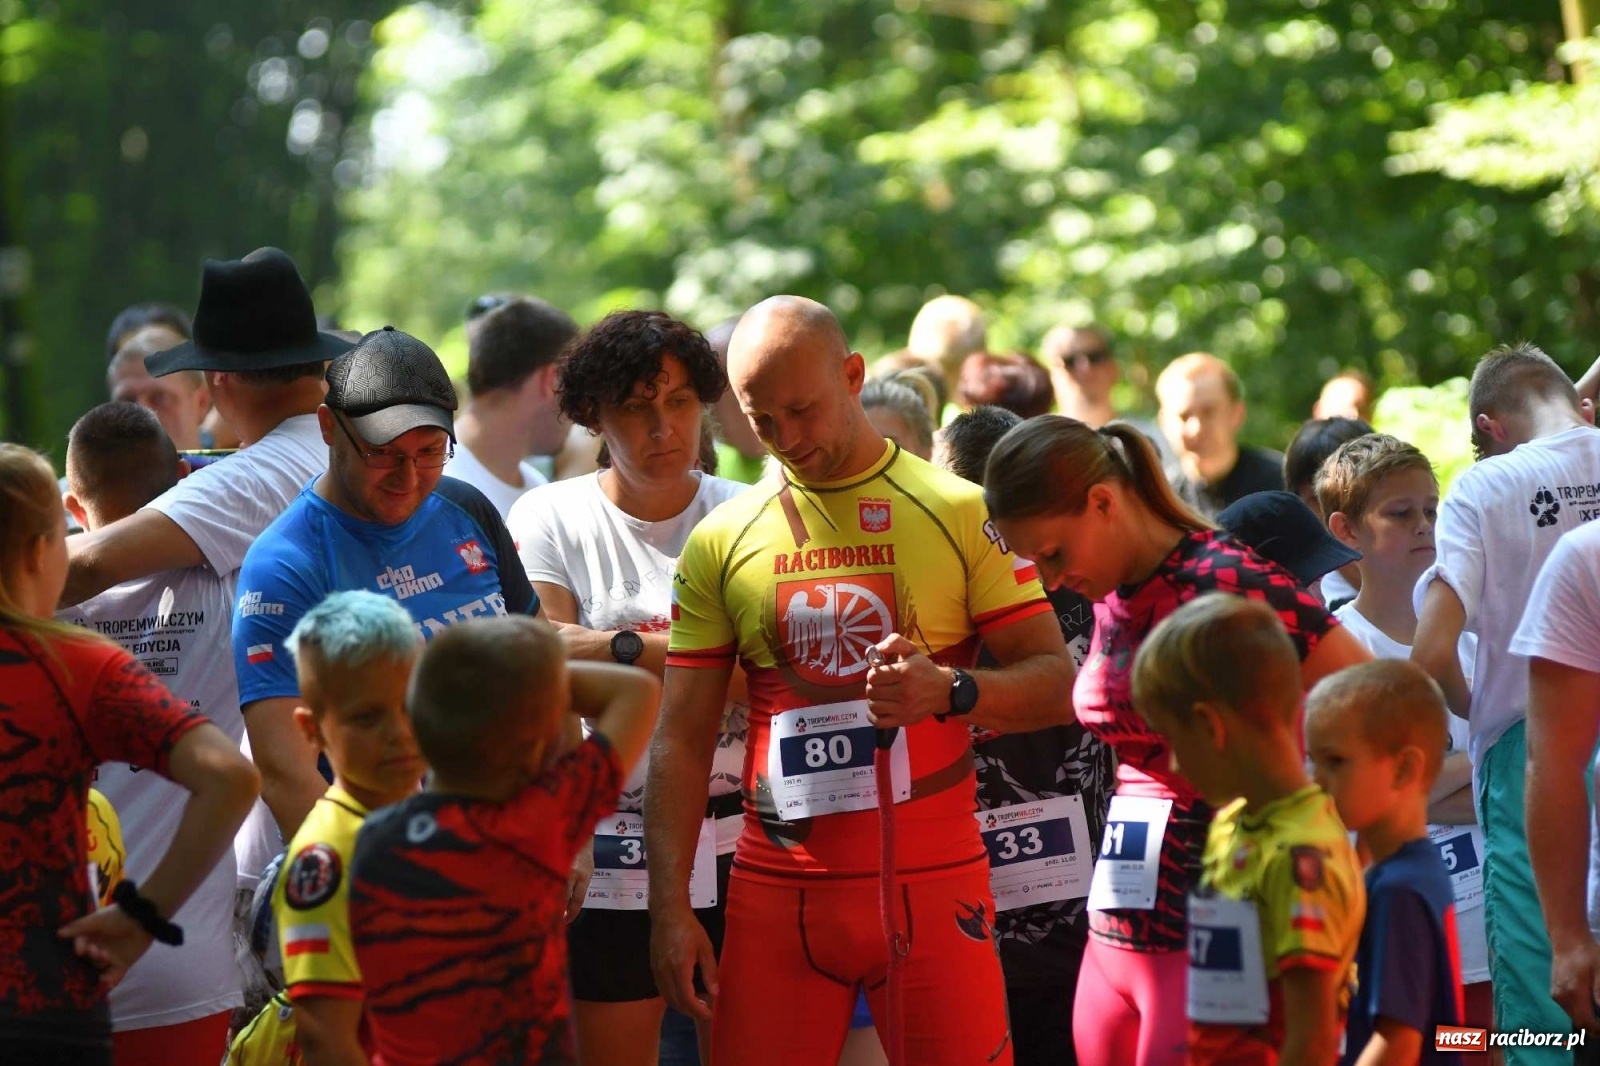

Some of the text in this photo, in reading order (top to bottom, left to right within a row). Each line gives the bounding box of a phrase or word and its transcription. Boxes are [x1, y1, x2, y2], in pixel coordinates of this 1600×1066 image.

[774, 543, 896, 574] RACIBORKI
[398, 572, 444, 600] okna
[134, 639, 181, 655] EDYCJA
[804, 734, 853, 768] 80
[619, 839, 646, 865] 3
[995, 826, 1044, 860] 33
